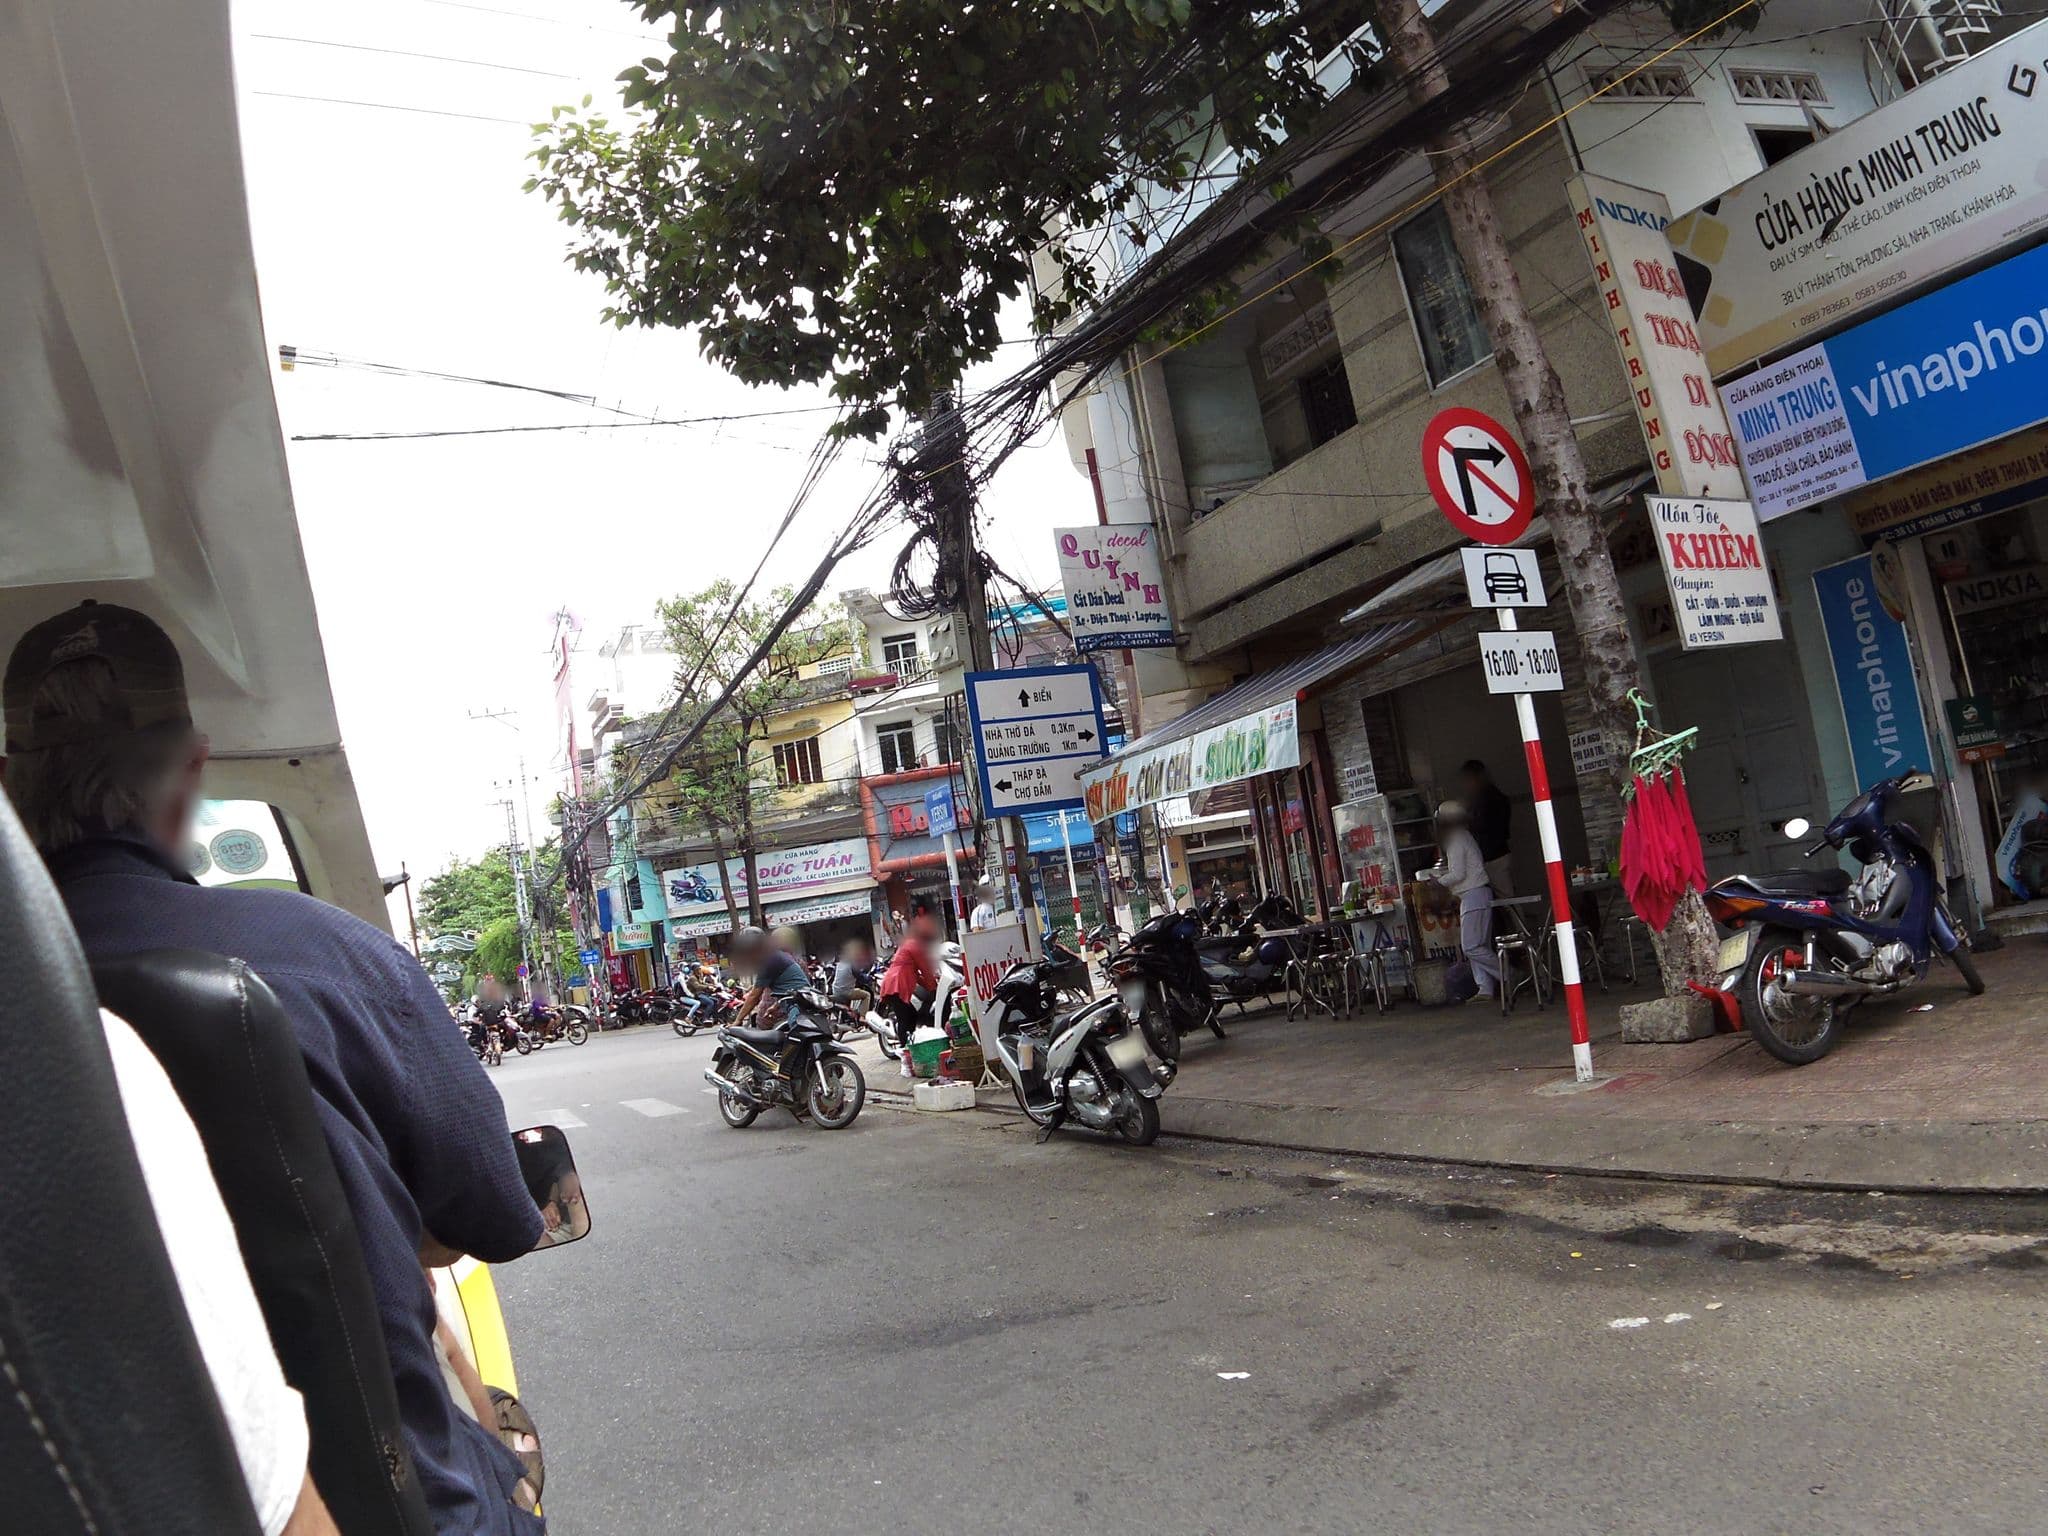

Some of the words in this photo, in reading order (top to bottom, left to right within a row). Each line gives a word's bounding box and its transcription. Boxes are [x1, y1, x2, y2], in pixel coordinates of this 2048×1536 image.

[1755, 192, 1803, 250] CỬA
[1797, 166, 1864, 229] HÀNG
[1858, 135, 1923, 198] MINH
[1915, 96, 2001, 166] TRUNG
[1798, 241, 1815, 258] SIM
[1882, 198, 1906, 216] LINH
[1908, 225, 1930, 245] NHA
[1576, 207, 1621, 310] MINH
[1619, 327, 1671, 471] TRUNG
[1682, 373, 1711, 408] DI
[1730, 385, 1749, 404] CỬA
[1749, 376, 1774, 397] HÀNG
[1737, 400, 1781, 444] MINH
[1777, 376, 1837, 426] TRUNG
[1753, 471, 1772, 488] TRAO
[1657, 502, 1690, 523] Uốn
[1106, 528, 1148, 547] decal
[1957, 571, 2043, 606] NOKIA
[1698, 631, 1725, 642] YERSIN
[1485, 649, 1518, 676] 16:00
[1526, 648, 1558, 675] 18:00
[1845, 577, 1902, 769] vinaphone
[1033, 686, 1052, 702] BIỂN
[985, 726, 1002, 741] NHÀ
[1023, 722, 1035, 737] ĐÁ
[987, 742, 1016, 759] QUẢNG
[1062, 740, 1078, 751] 1Km
[1012, 768, 1034, 782] THÁP
[1036, 766, 1048, 780] BÀ
[759, 861, 794, 879] ĐỨC
[802, 850, 853, 872] TUẤN
